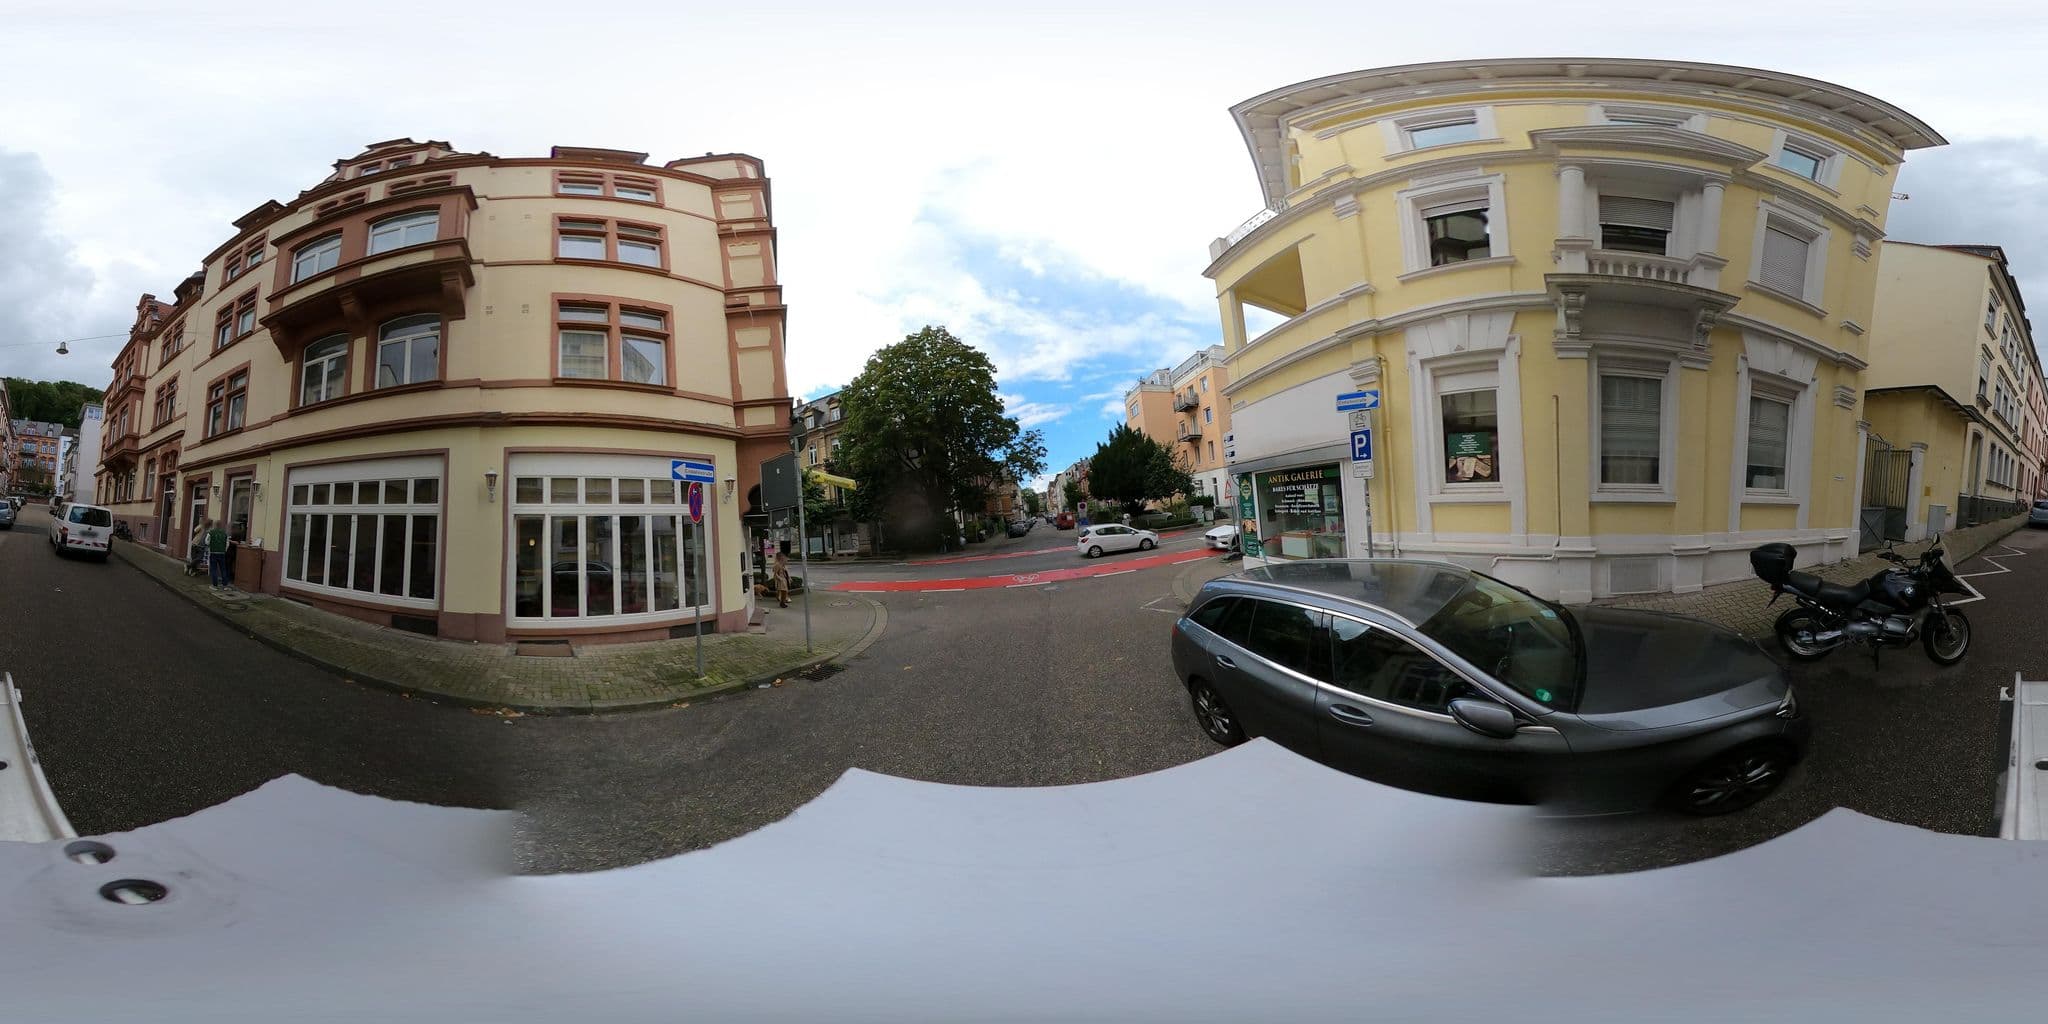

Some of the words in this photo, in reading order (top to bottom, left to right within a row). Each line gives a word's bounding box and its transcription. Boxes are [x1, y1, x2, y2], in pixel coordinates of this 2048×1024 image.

[1354, 434, 1366, 458] P
[1268, 474, 1290, 484] ANTIK
[1290, 470, 1324, 482] GALERIE
